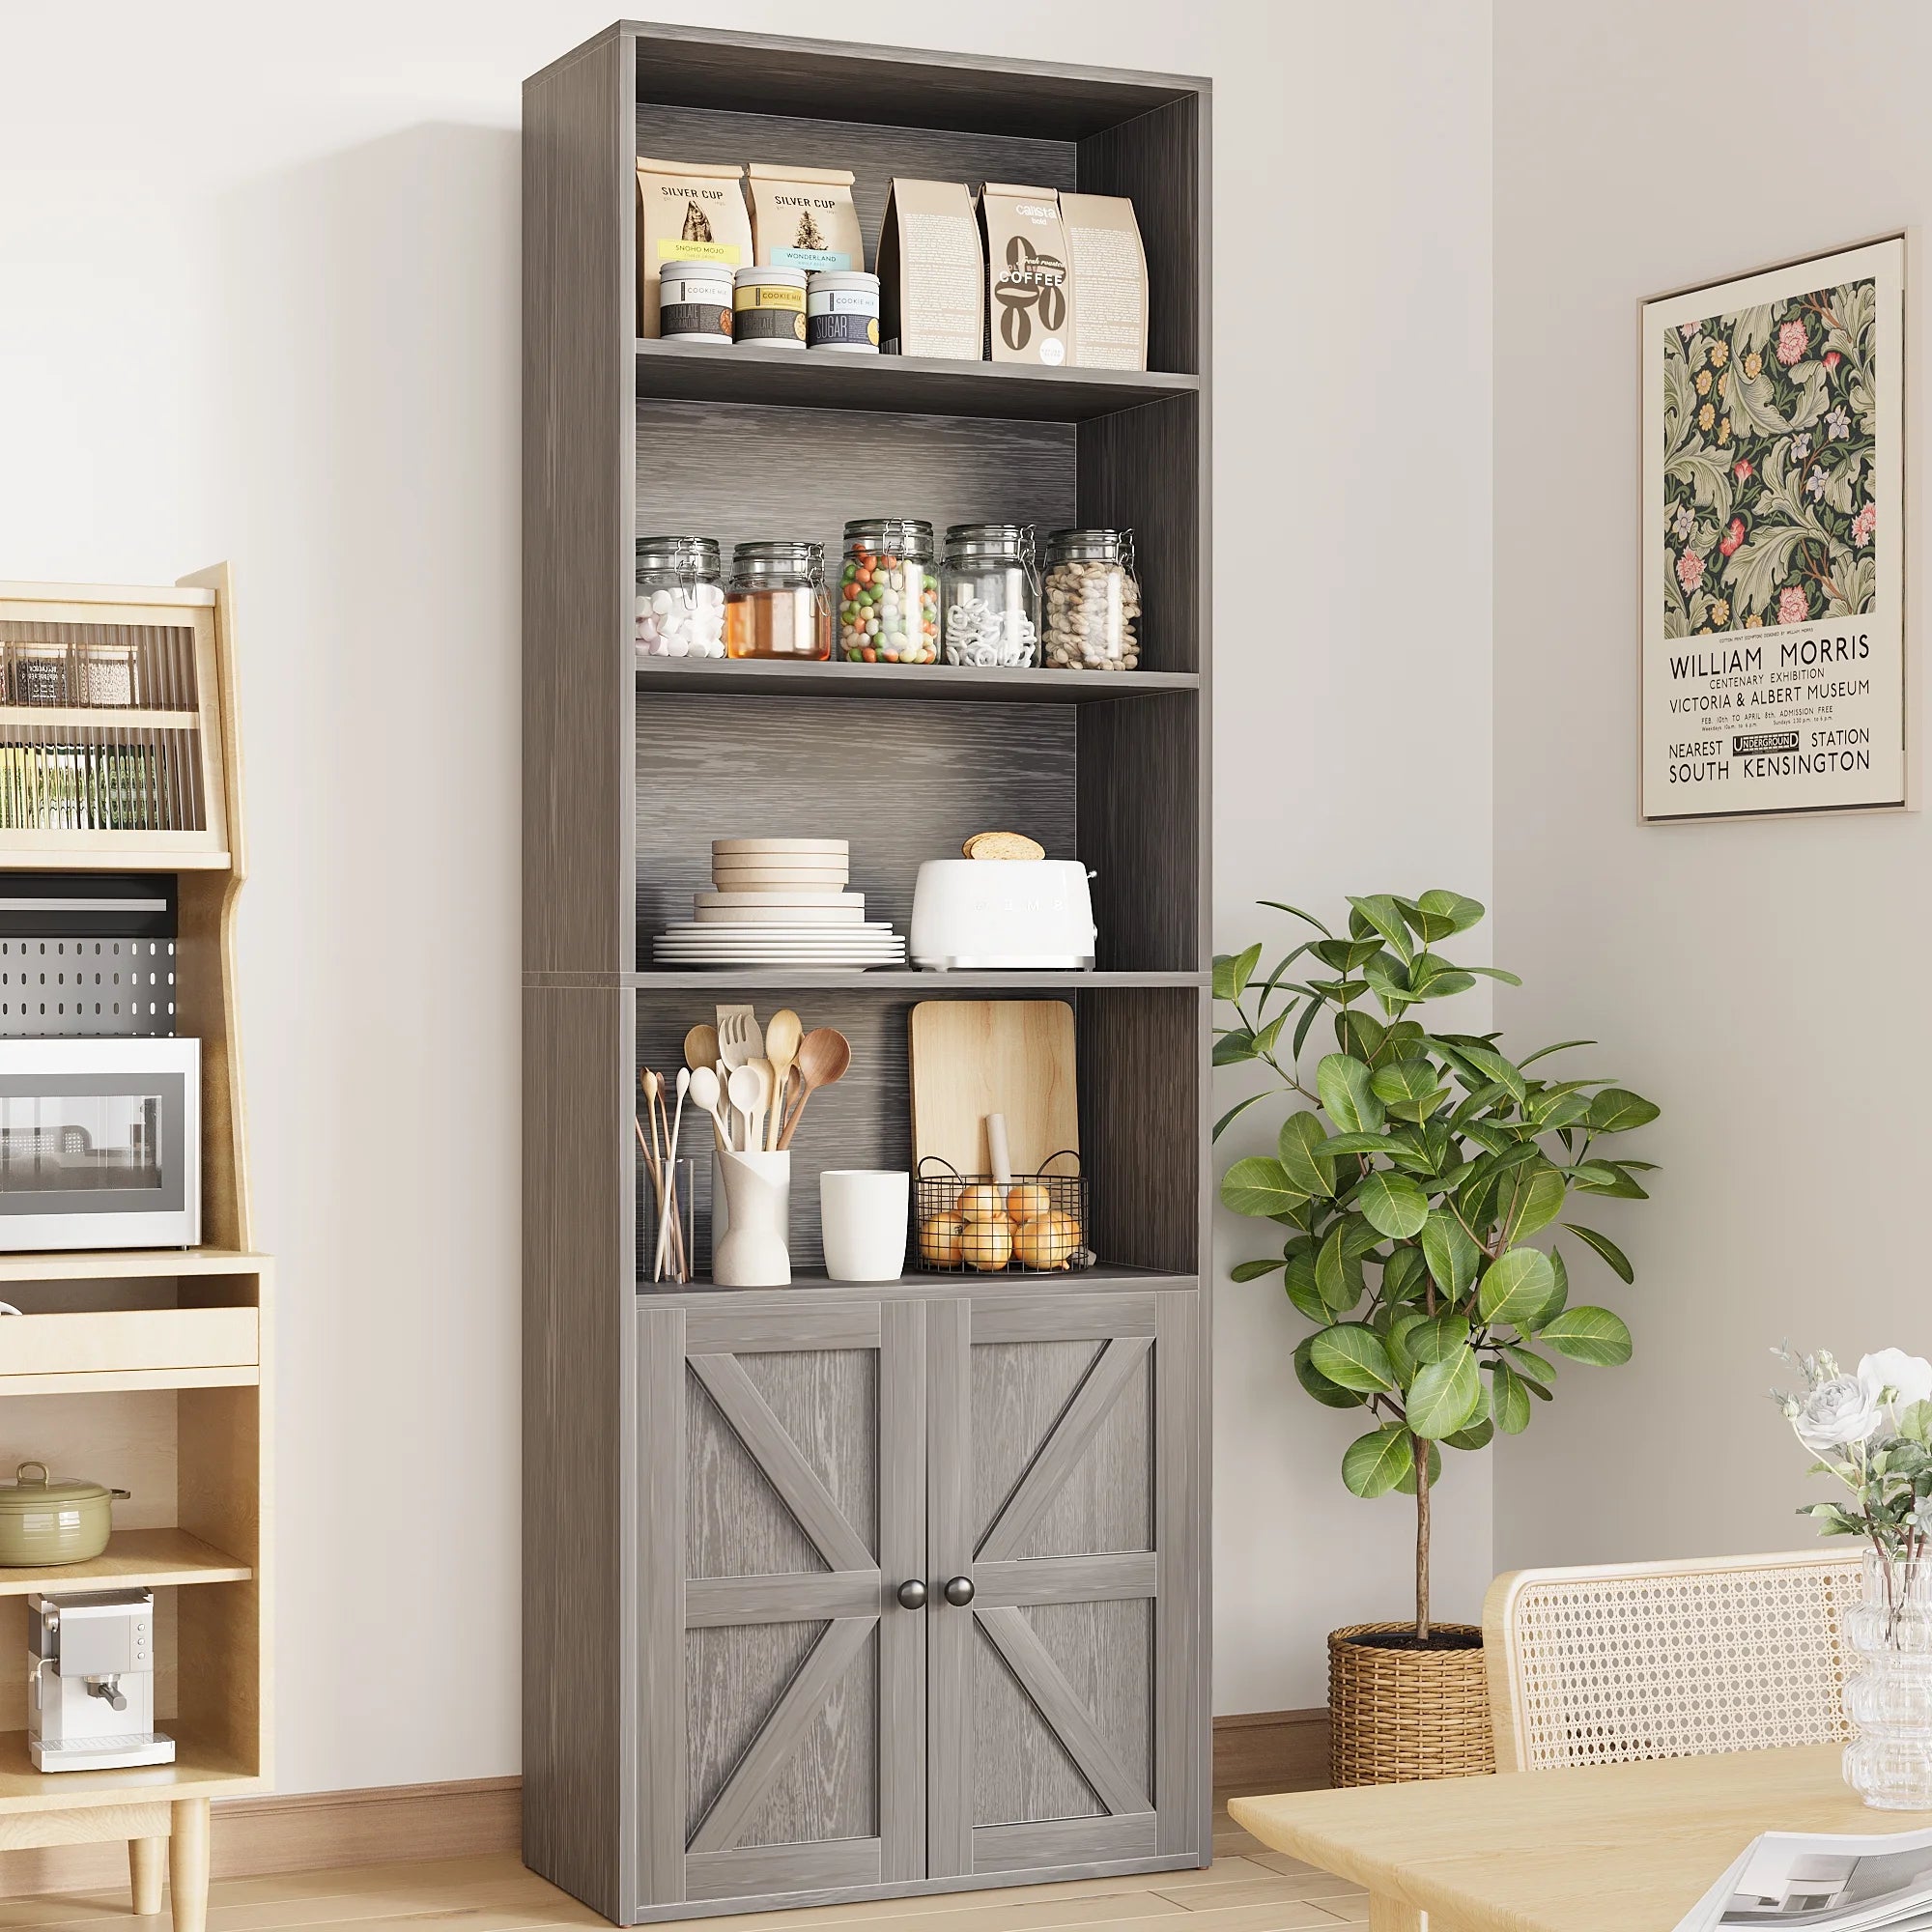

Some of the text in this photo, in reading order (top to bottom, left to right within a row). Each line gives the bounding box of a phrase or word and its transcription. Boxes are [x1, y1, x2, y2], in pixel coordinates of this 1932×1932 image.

[661, 186, 723, 199] SILVER CUP
[775, 195, 835, 209] SILVER CUP
[786, 253, 837, 263] WONDERLAND
[999, 270, 1063, 287] COFFEE
[816, 315, 847, 338] SUGAR
[1669, 634, 1870, 680] WILLIAM MORRIS
[1710, 668, 1825, 690] CENTENARY EXHIBITION
[1669, 679, 1870, 714] VICTORIA & ALBERT MUSEUM
[1779, 707, 1814, 717] ADMISSION
[1669, 728, 1870, 759] NEAREST UNDERGROUND STATION
[1669, 750, 1870, 784] SOUTH KENSINGTON
